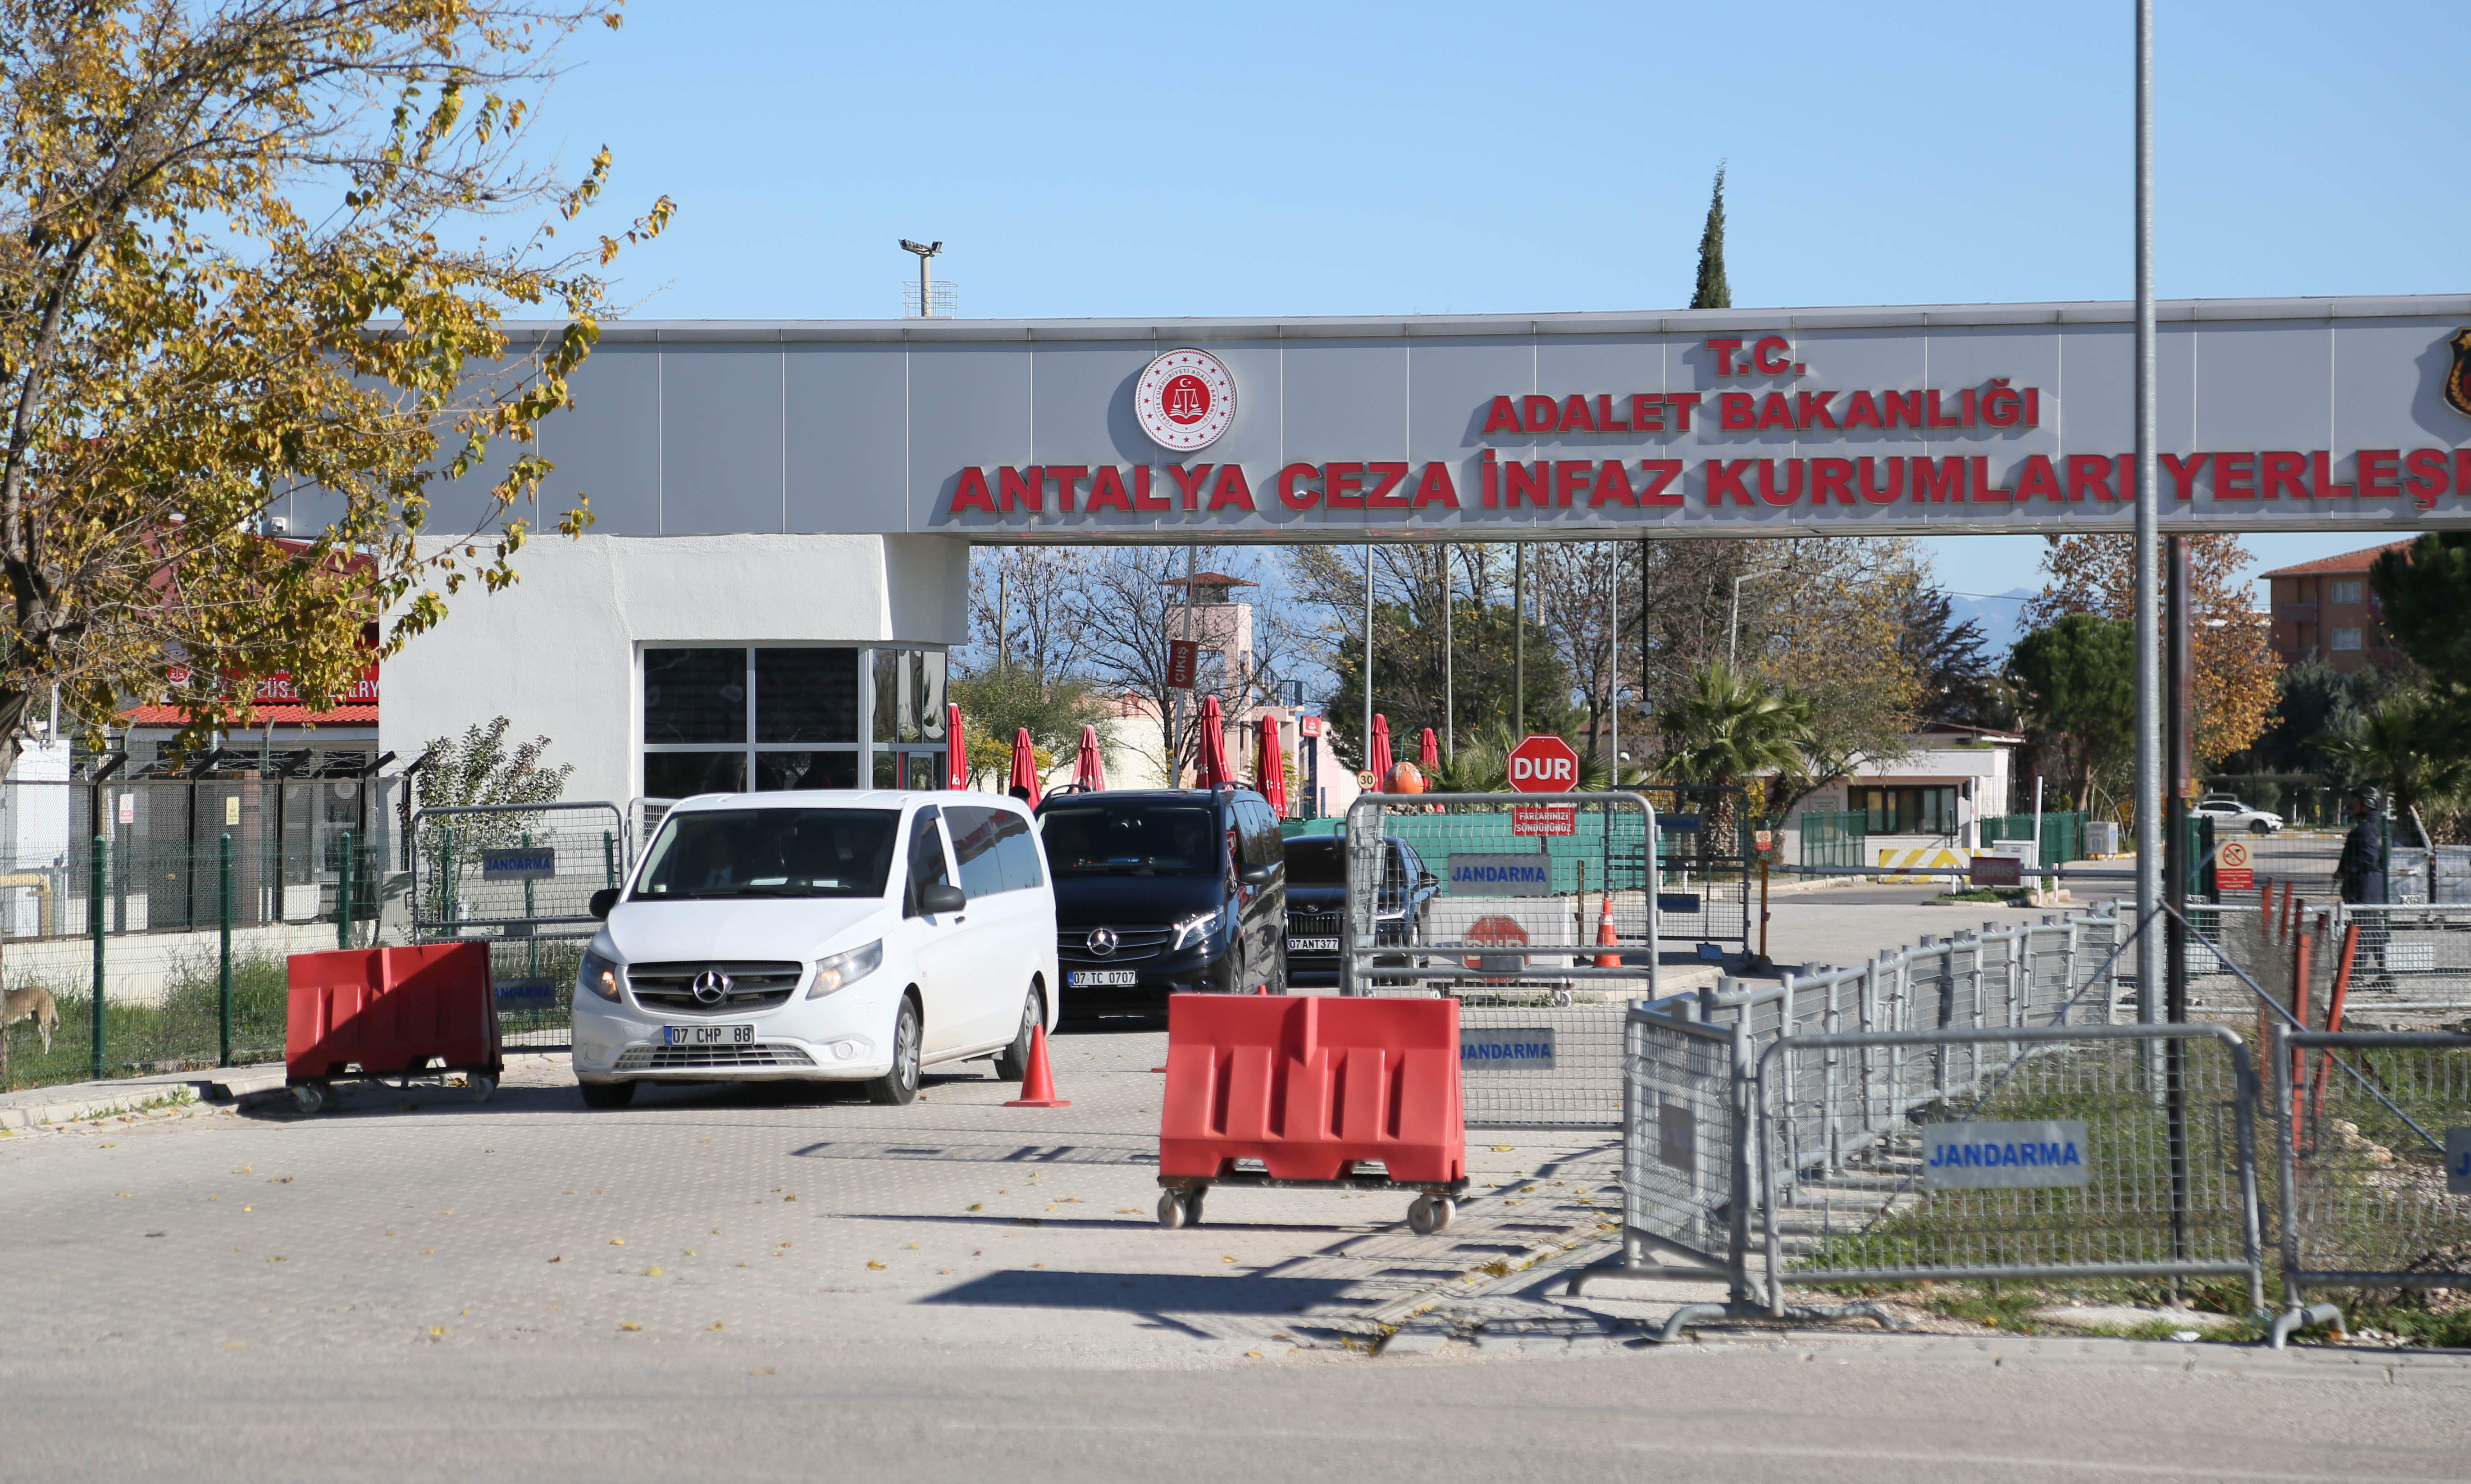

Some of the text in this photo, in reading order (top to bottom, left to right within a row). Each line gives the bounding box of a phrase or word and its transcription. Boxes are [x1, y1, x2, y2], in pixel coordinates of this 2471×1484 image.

[1705, 336, 1807, 377] T.C.
[1155, 368, 1190, 400] CUMHURİYETİ
[1191, 370, 1214, 387] ADALET
[1155, 402, 1174, 427] TÜRKİYE
[1482, 379, 2040, 434] ADALET BAKANLIĞI
[948, 463, 1258, 513] ANTALYA
[1277, 460, 1463, 511] CEZA
[1482, 448, 1684, 509] İNFAZ
[1705, 454, 2136, 507] KURUMLARI
[1175, 646, 1190, 682] ÇIKIŞ
[1360, 775, 1373, 785] 30
[1515, 757, 1572, 780] DUR
[485, 858, 551, 871] JANDARMA
[1451, 866, 1547, 883] JANDARMA
[1975, 863, 2015, 880] GİRİŞ
[1074, 972, 1086, 984] 07
[1091, 972, 1103, 983] TC
[1109, 972, 1135, 983] 0707
[673, 1028, 689, 1043] 07
[697, 1028, 721, 1043] CHP
[734, 1027, 751, 1042] 88
[1930, 1142, 2081, 1169] JANDARMA
